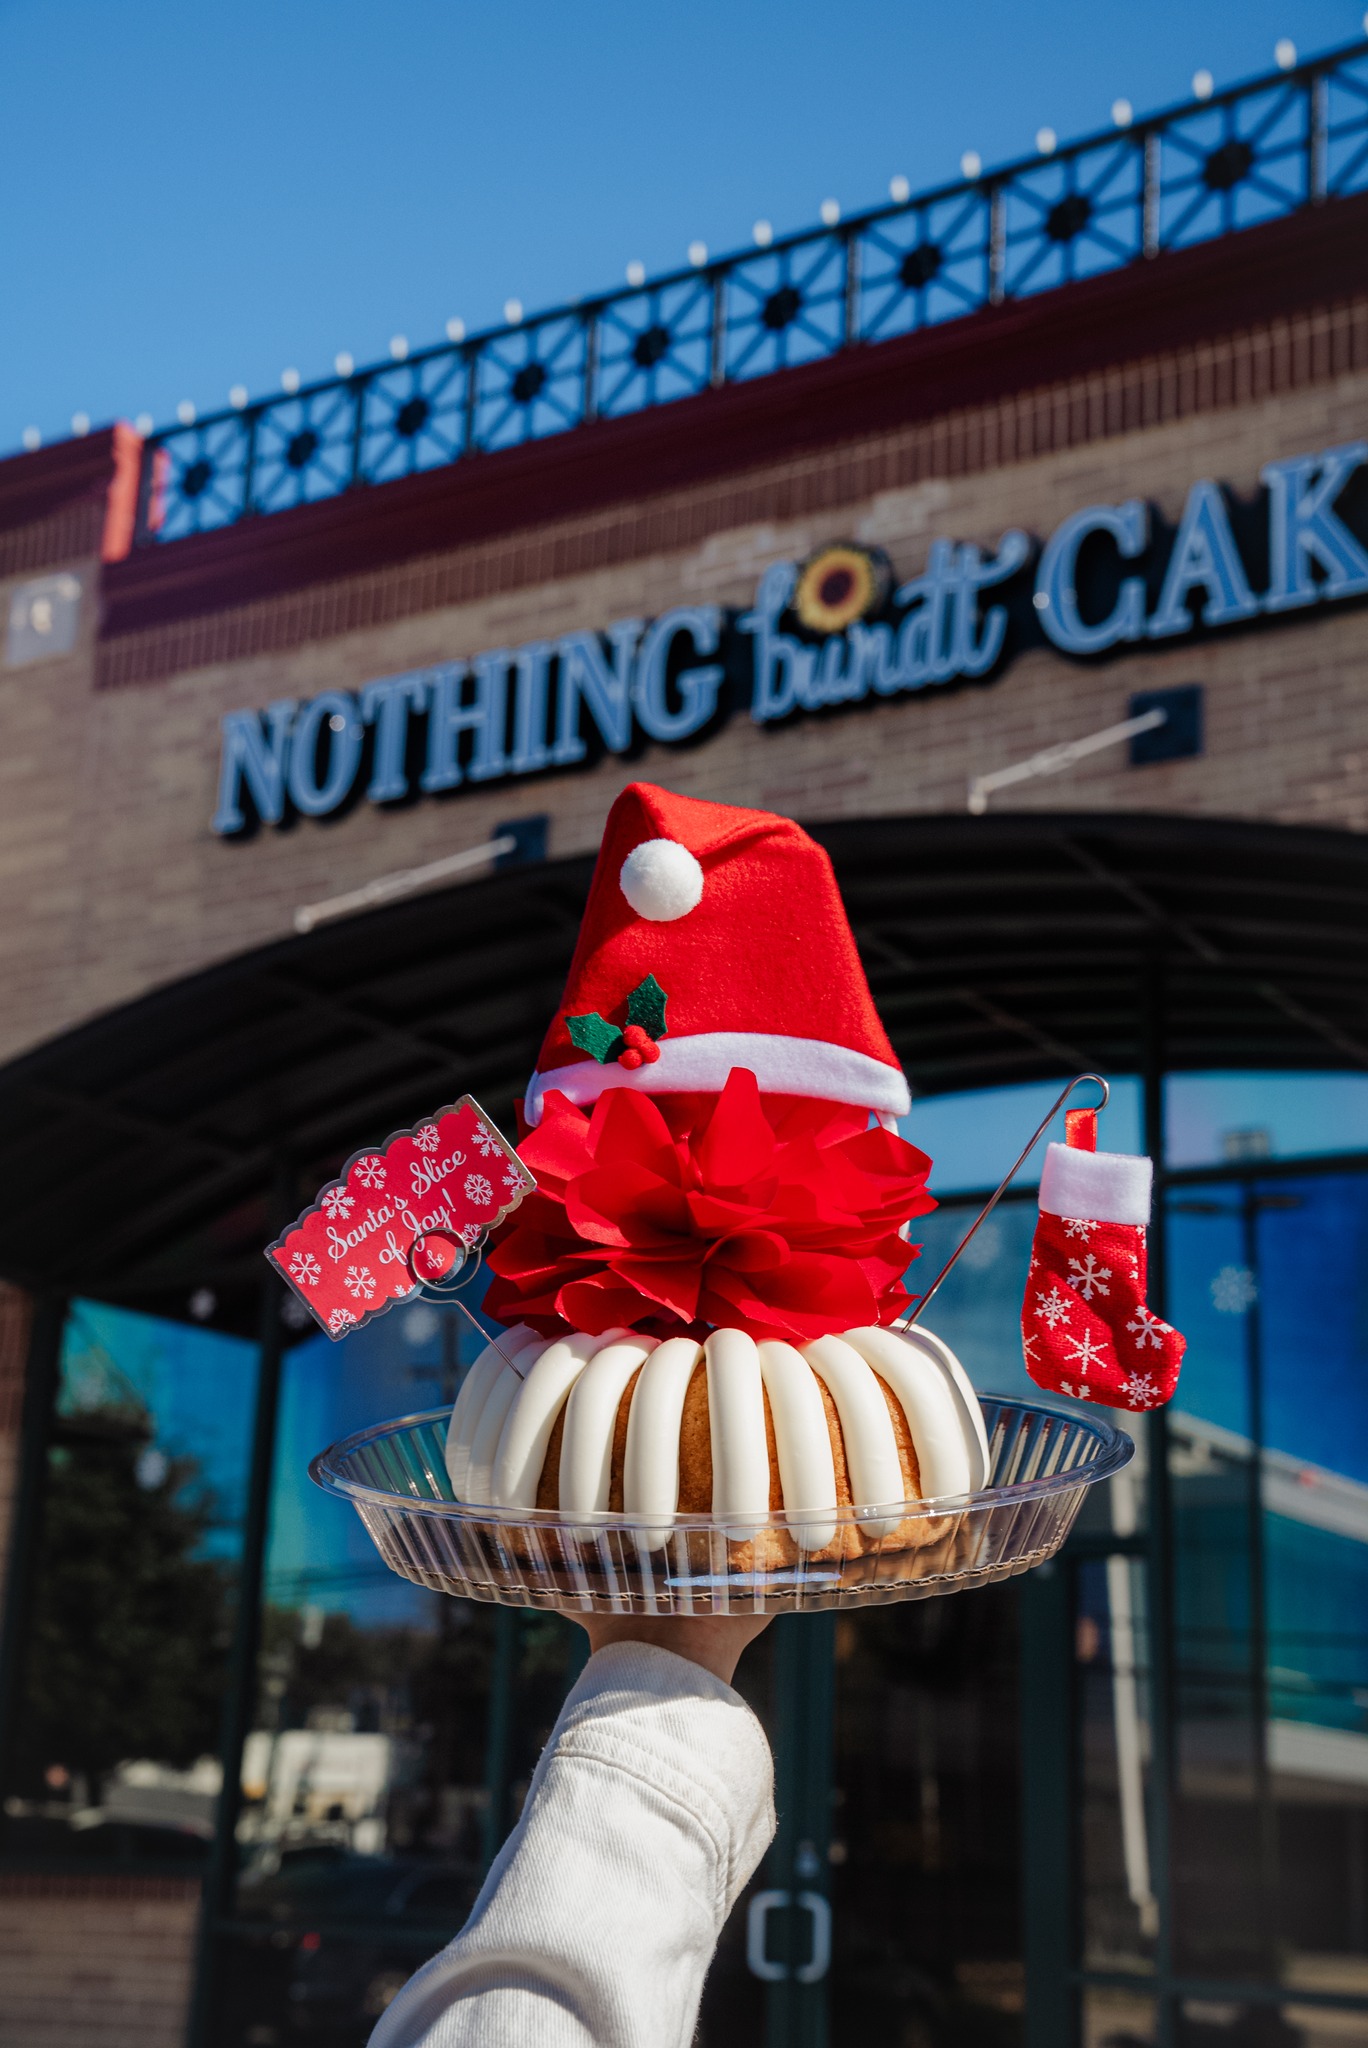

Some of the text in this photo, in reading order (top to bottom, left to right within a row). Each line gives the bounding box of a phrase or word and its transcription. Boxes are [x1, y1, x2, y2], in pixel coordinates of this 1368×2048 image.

[213, 439, 1368, 834] NOTHING bundt CAK
[326, 1150, 467, 1264] Santa's Slice
[378, 1188, 457, 1267] of Joy!
